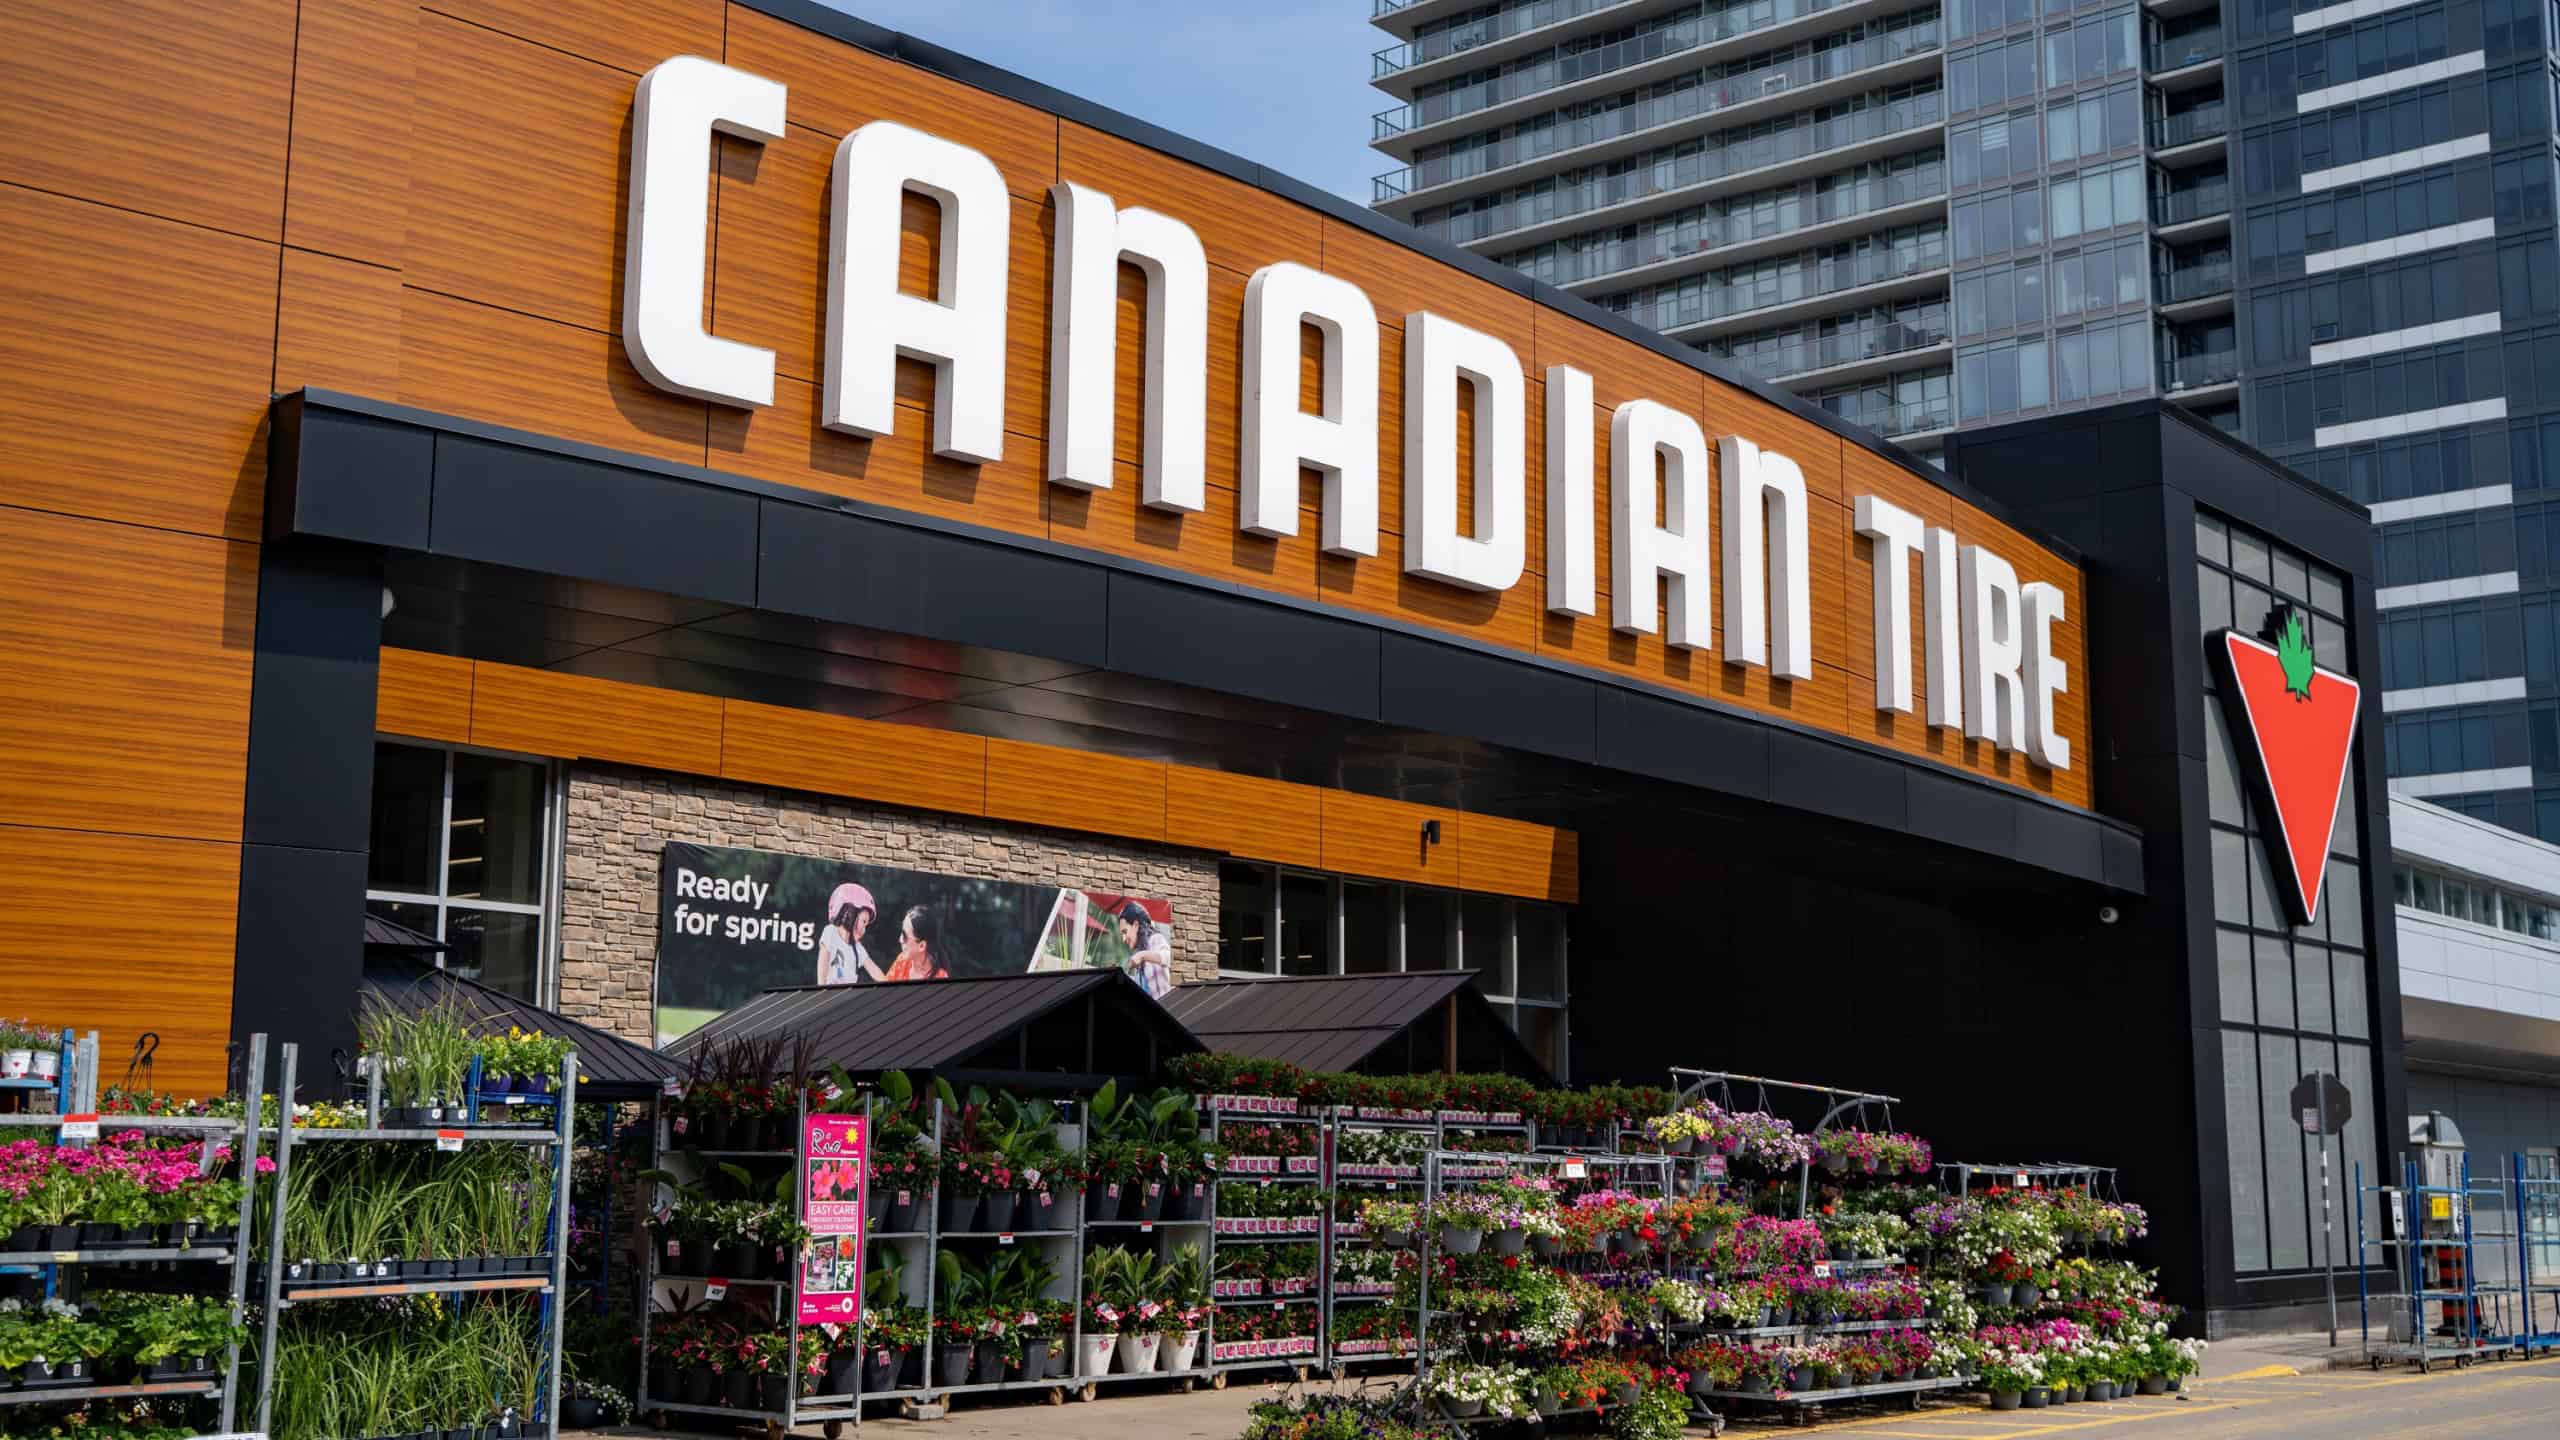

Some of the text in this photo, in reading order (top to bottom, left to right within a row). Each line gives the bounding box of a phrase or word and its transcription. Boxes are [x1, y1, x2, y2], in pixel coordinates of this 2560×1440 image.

[622, 54, 2070, 770] CANADIAN TIRE
[676, 867, 769, 910] Ready
[674, 904, 815, 950] for spring
[811, 1205, 857, 1216] EASY CARE
